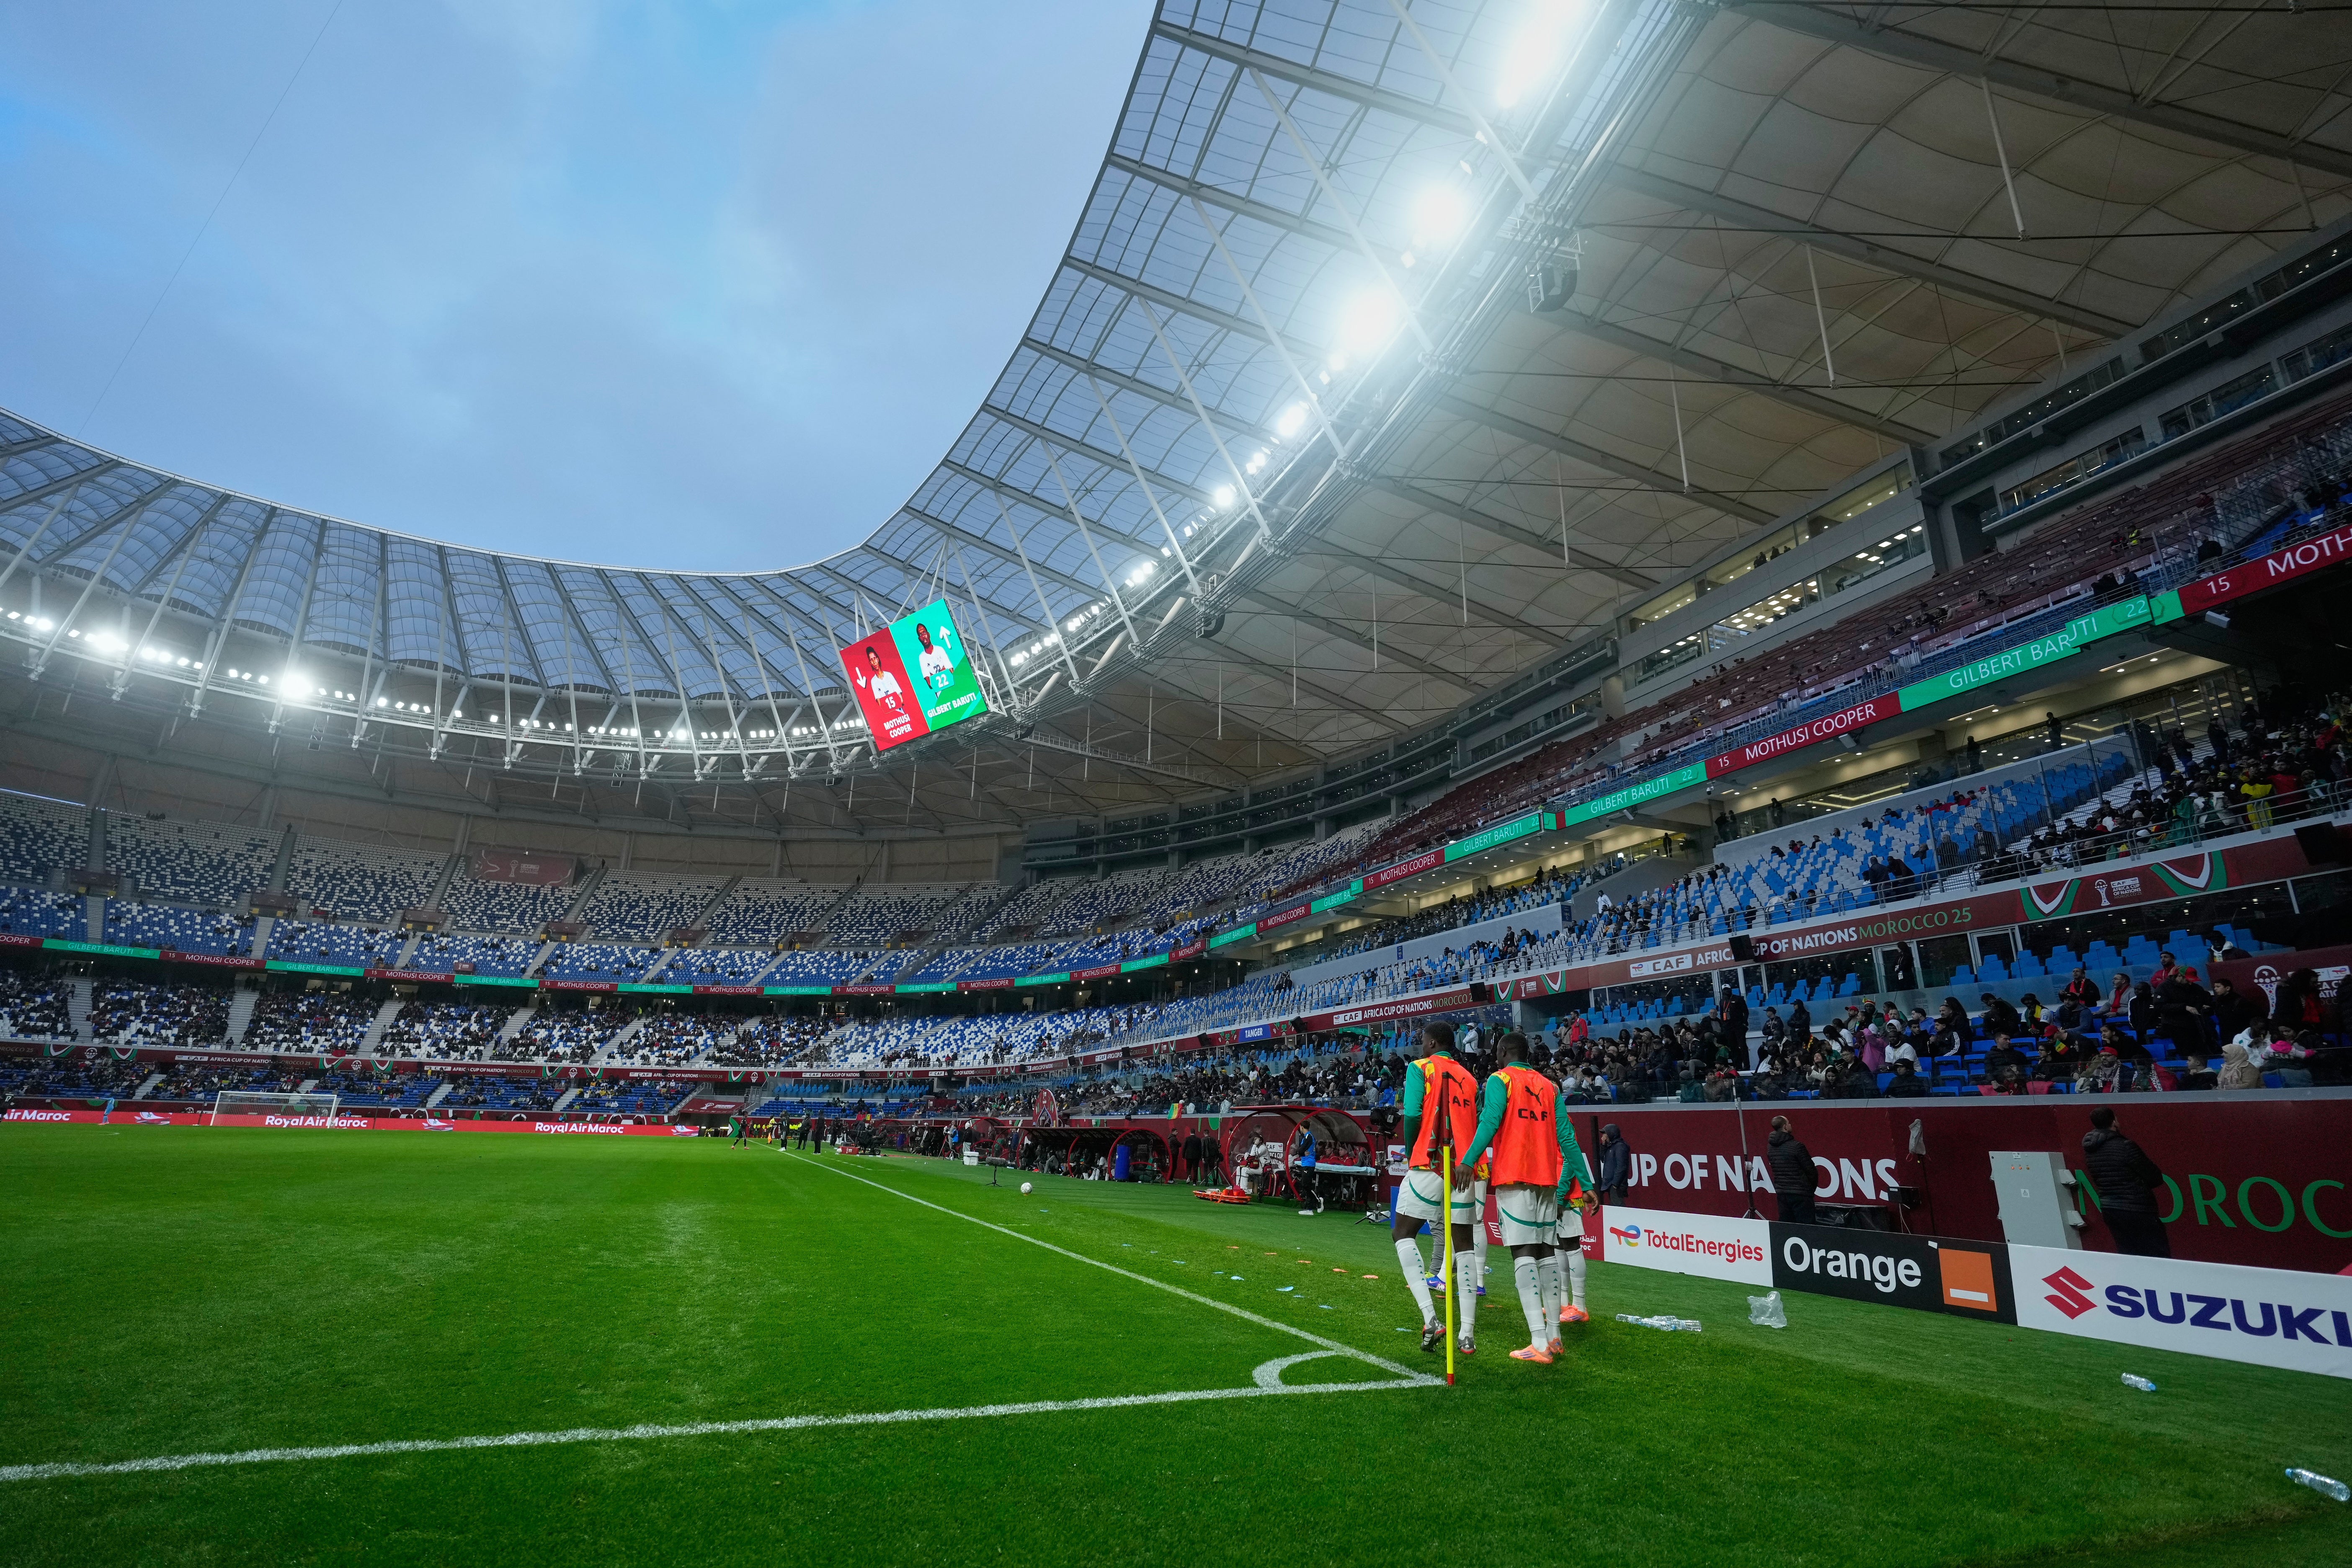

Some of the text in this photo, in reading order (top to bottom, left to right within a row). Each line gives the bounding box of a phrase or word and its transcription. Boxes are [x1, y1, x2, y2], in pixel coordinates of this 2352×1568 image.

[2207, 576, 2230, 594] 15
[1950, 650, 2022, 688] GILBERT
[2125, 600, 2147, 617] 22
[936, 674, 949, 688] 22
[885, 696, 896, 709] 15
[927, 692, 977, 718] GILBERT BARUTI
[884, 714, 910, 730] MOTHUSI
[890, 724, 912, 738] COOPER
[1718, 704, 1876, 767] 15 MOTHUSI COOPER
[1591, 769, 1692, 814] GILBERT BARUTI 22
[1464, 816, 1539, 852] GILBERT BARUTI 22
[1380, 864, 1408, 882] MOTHUSI
[1409, 854, 1435, 872] COOPER
[1324, 893, 1342, 907] GILBERT
[1268, 914, 1287, 926] MOTHUSI
[1287, 907, 1305, 919] COOPER
[0, 935, 30, 944] OOPER
[1219, 933, 1231, 943] GILBERT
[1233, 929, 1245, 939] BARUTI
[1653, 907, 1972, 972] CAF AFRIC OF NATIONS MOROCCO 25
[68, 943, 101, 952] GILBERT
[103, 946, 134, 955] BARUTI
[1179, 947, 1194, 957] MOTHUSI
[186, 954, 222, 963] MOTHUSI
[224, 958, 255, 966] COOPER
[1131, 960, 1145, 969] GILBERT
[1344, 994, 1467, 1022] CAF AFRICA CUP OF NATIONS MOROCCO
[1245, 1028, 1263, 1038] TANGER
[1452, 1096, 1471, 1108] AF
[21, 1110, 71, 1121] Maroc
[265, 1116, 304, 1128] Royal
[304, 1116, 325, 1126] Air
[1518, 1108, 1548, 1122] CAF
[535, 1122, 624, 1134] Royal Air Maroc
[1627, 1153, 1899, 1201] UP OF NAONS
[1644, 1228, 1763, 1263] TotalEnergies
[1783, 1236, 1921, 1293] Orange
[2104, 1284, 2352, 1348] SUZUKI
